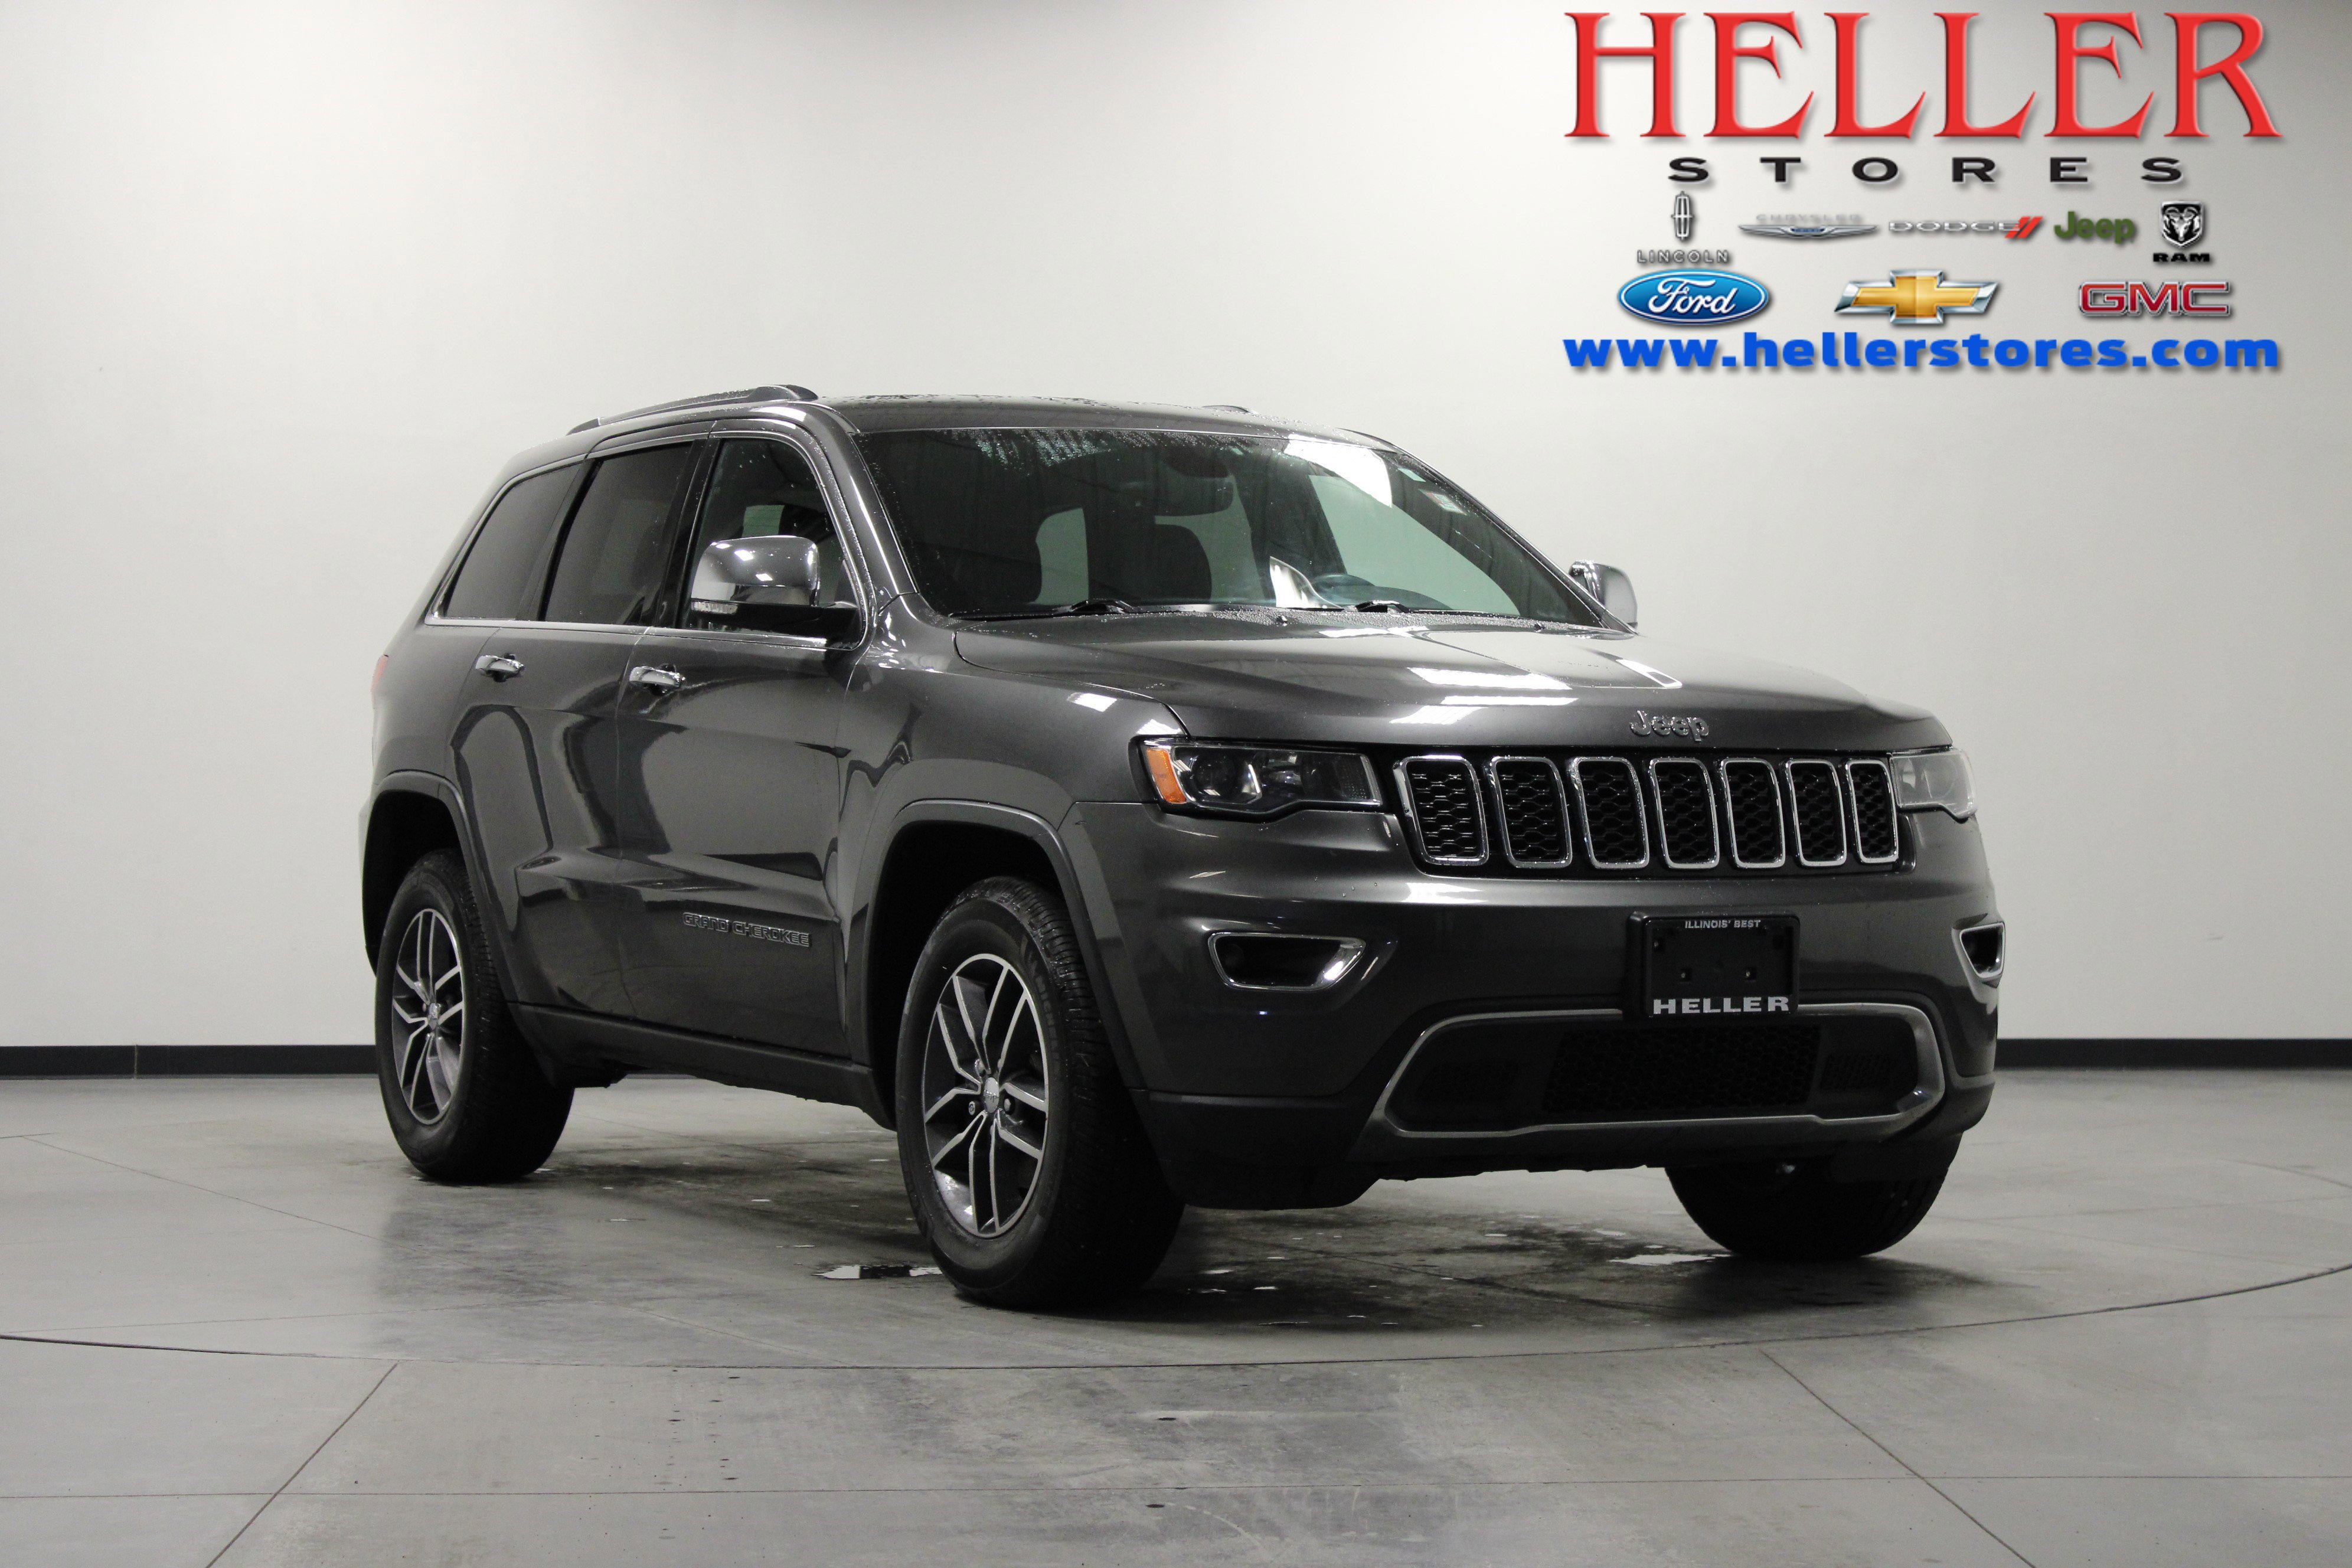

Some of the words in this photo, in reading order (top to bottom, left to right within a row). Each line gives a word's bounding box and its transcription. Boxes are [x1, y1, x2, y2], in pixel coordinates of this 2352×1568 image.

[1629, 710, 1710, 741] Jeep
[682, 912, 730, 933] GRAND
[733, 921, 810, 947] CHEROKEE
[1733, 919, 1761, 928] BEST
[1653, 996, 1789, 1014] HELLER
